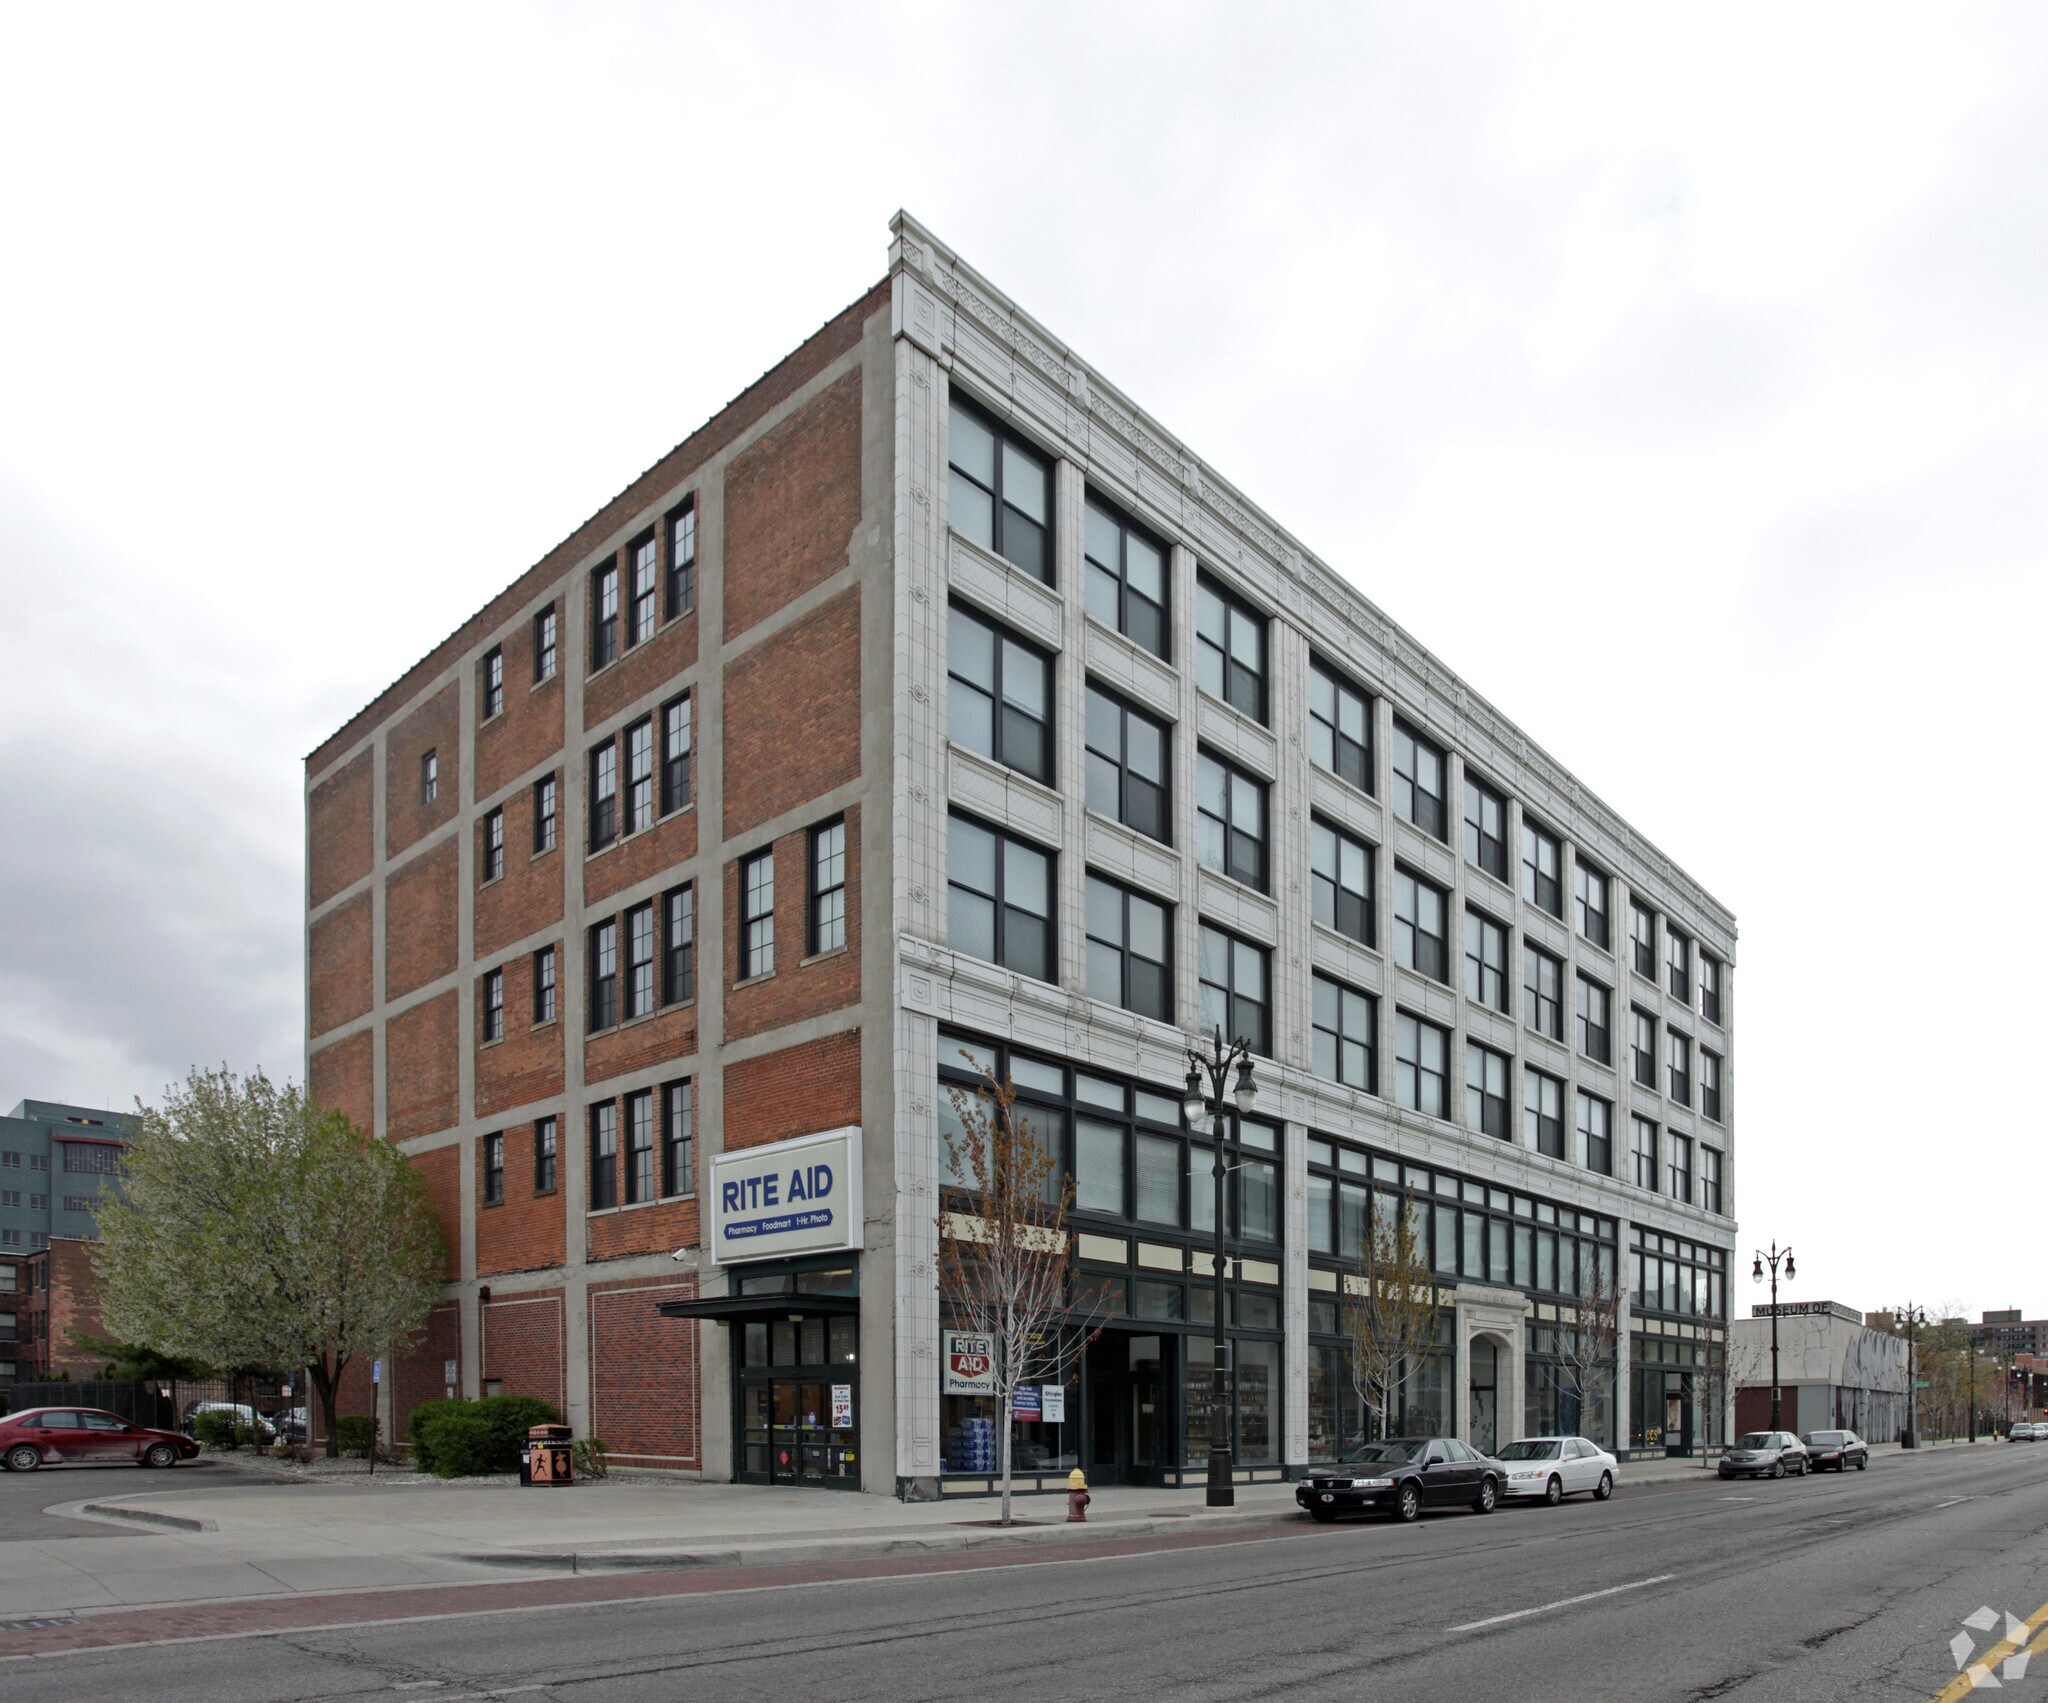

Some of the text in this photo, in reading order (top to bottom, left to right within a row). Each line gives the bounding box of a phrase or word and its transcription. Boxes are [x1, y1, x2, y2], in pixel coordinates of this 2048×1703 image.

[722, 1164, 833, 1213] RITE AID
[728, 1224, 758, 1236] Pharmacy
[762, 1219, 791, 1231] Foodmart
[810, 1213, 828, 1224] Photo
[1812, 1302, 1829, 1313] OF
[955, 1339, 985, 1354] RITE
[957, 1356, 983, 1371] AID
[949, 1378, 990, 1390] Pharmacy
